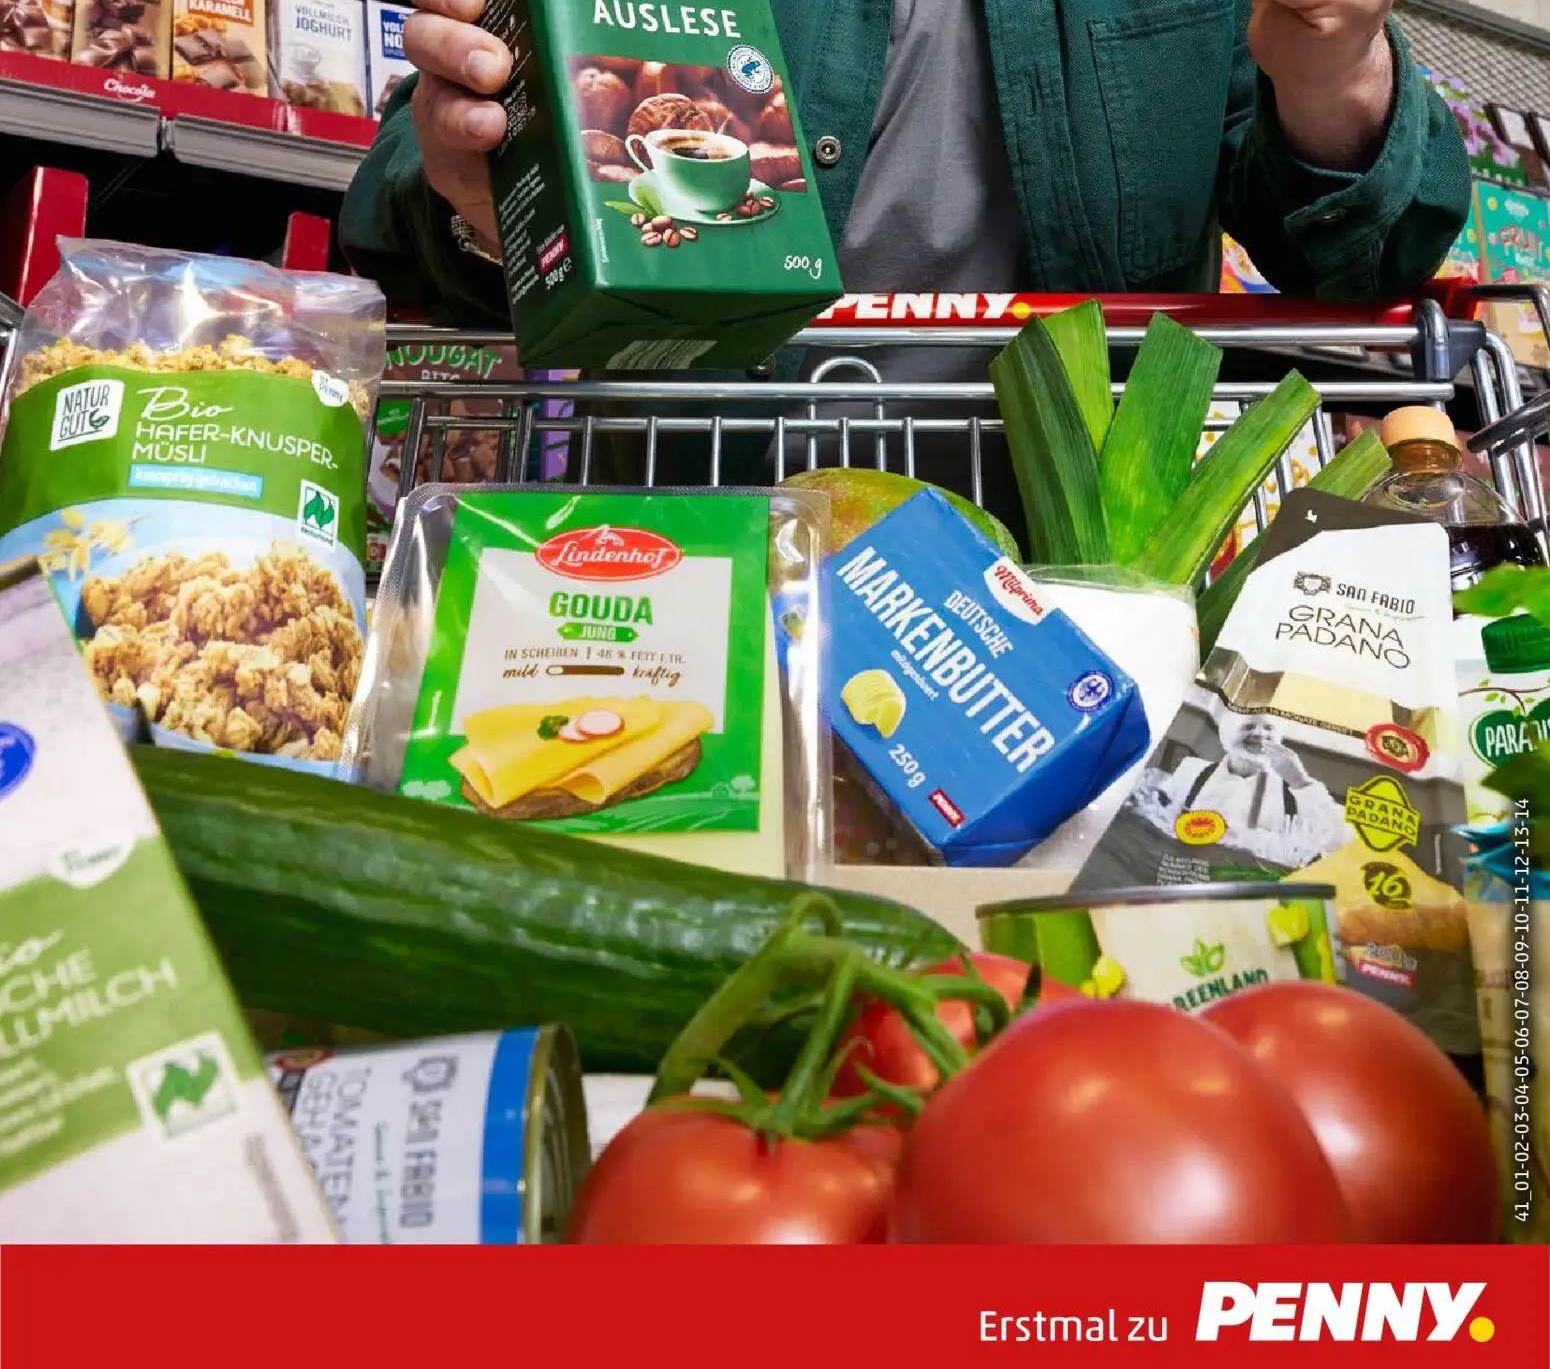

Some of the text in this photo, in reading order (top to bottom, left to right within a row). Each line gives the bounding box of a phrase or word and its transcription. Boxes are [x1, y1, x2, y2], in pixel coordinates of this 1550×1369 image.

[295, 15, 352, 41] JOGHURT
[784, 254, 810, 271] 500
[816, 292, 1031, 320] PENNY.
[64, 383, 110, 414] NATUR
[137, 386, 235, 421] Bio
[59, 412, 88, 438] GUT
[132, 441, 207, 464] MÜSLI
[136, 421, 339, 470] HAFER-KNUSPER-
[551, 541, 669, 568] Lindenhof
[994, 565, 1045, 617] Milprima
[1336, 582, 1367, 602] SAN
[1371, 590, 1416, 615] FABIO
[548, 591, 653, 626] GOUDA
[580, 622, 617, 641] JUNG
[943, 590, 1014, 660] DEUTSCHE
[1289, 604, 1404, 650] GRANA
[503, 647, 517, 660] IN
[521, 646, 579, 660] SCHEIBEN
[836, 546, 1056, 773] MARKENBUTTER
[1275, 622, 1411, 669] PADANO
[502, 663, 540, 680] mild
[887, 743, 919, 775] 250
[1347, 807, 1416, 836] PADANO
[1349, 795, 1416, 826] GRANA
[1367, 871, 1404, 897] 16
[1172, 968, 1270, 1012] REENLAND
[0, 955, 178, 1059] LLMILCH
[399, 1149, 438, 1229] FABIO
